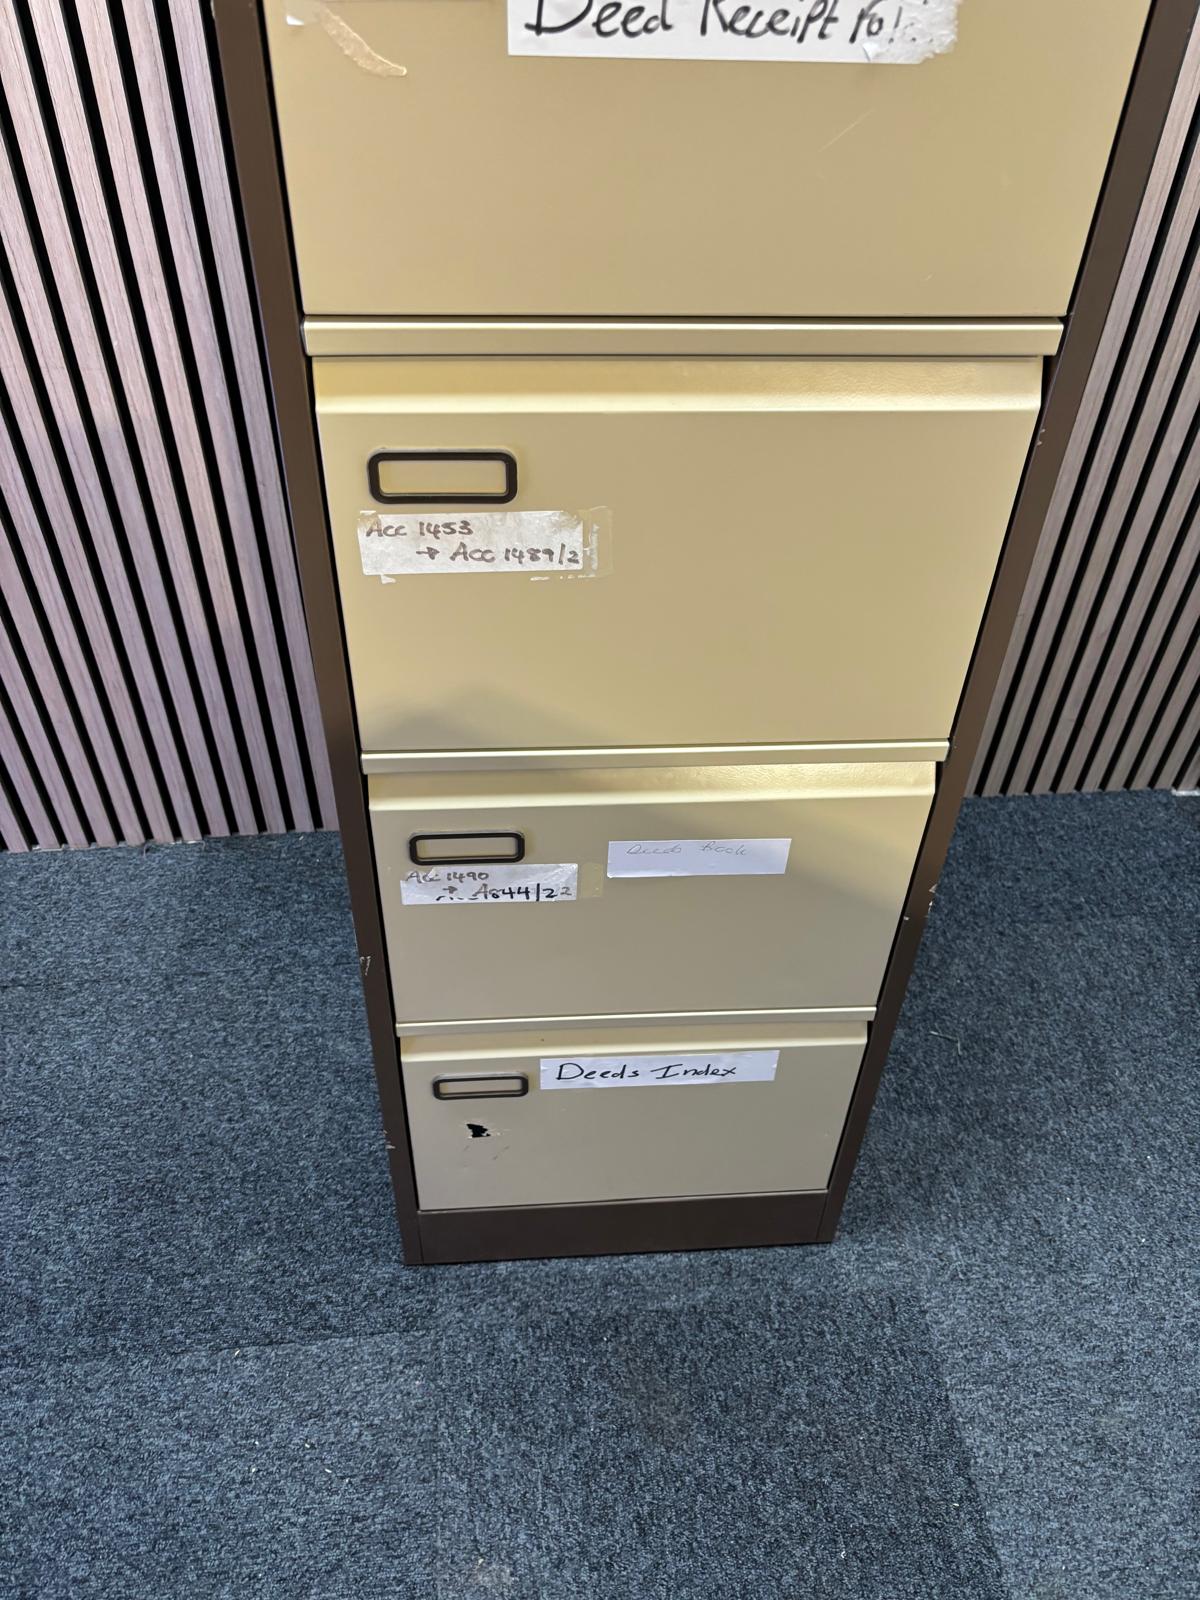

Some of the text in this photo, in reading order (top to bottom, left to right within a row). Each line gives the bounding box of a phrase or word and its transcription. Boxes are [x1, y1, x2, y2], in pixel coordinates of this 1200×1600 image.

[524, 0, 673, 38] Deed
[365, 520, 474, 539] Acc 1453
[449, 542, 496, 563] Acc
[405, 870, 490, 884] Acc 1490
[555, 1062, 738, 1081] Deeds Index
